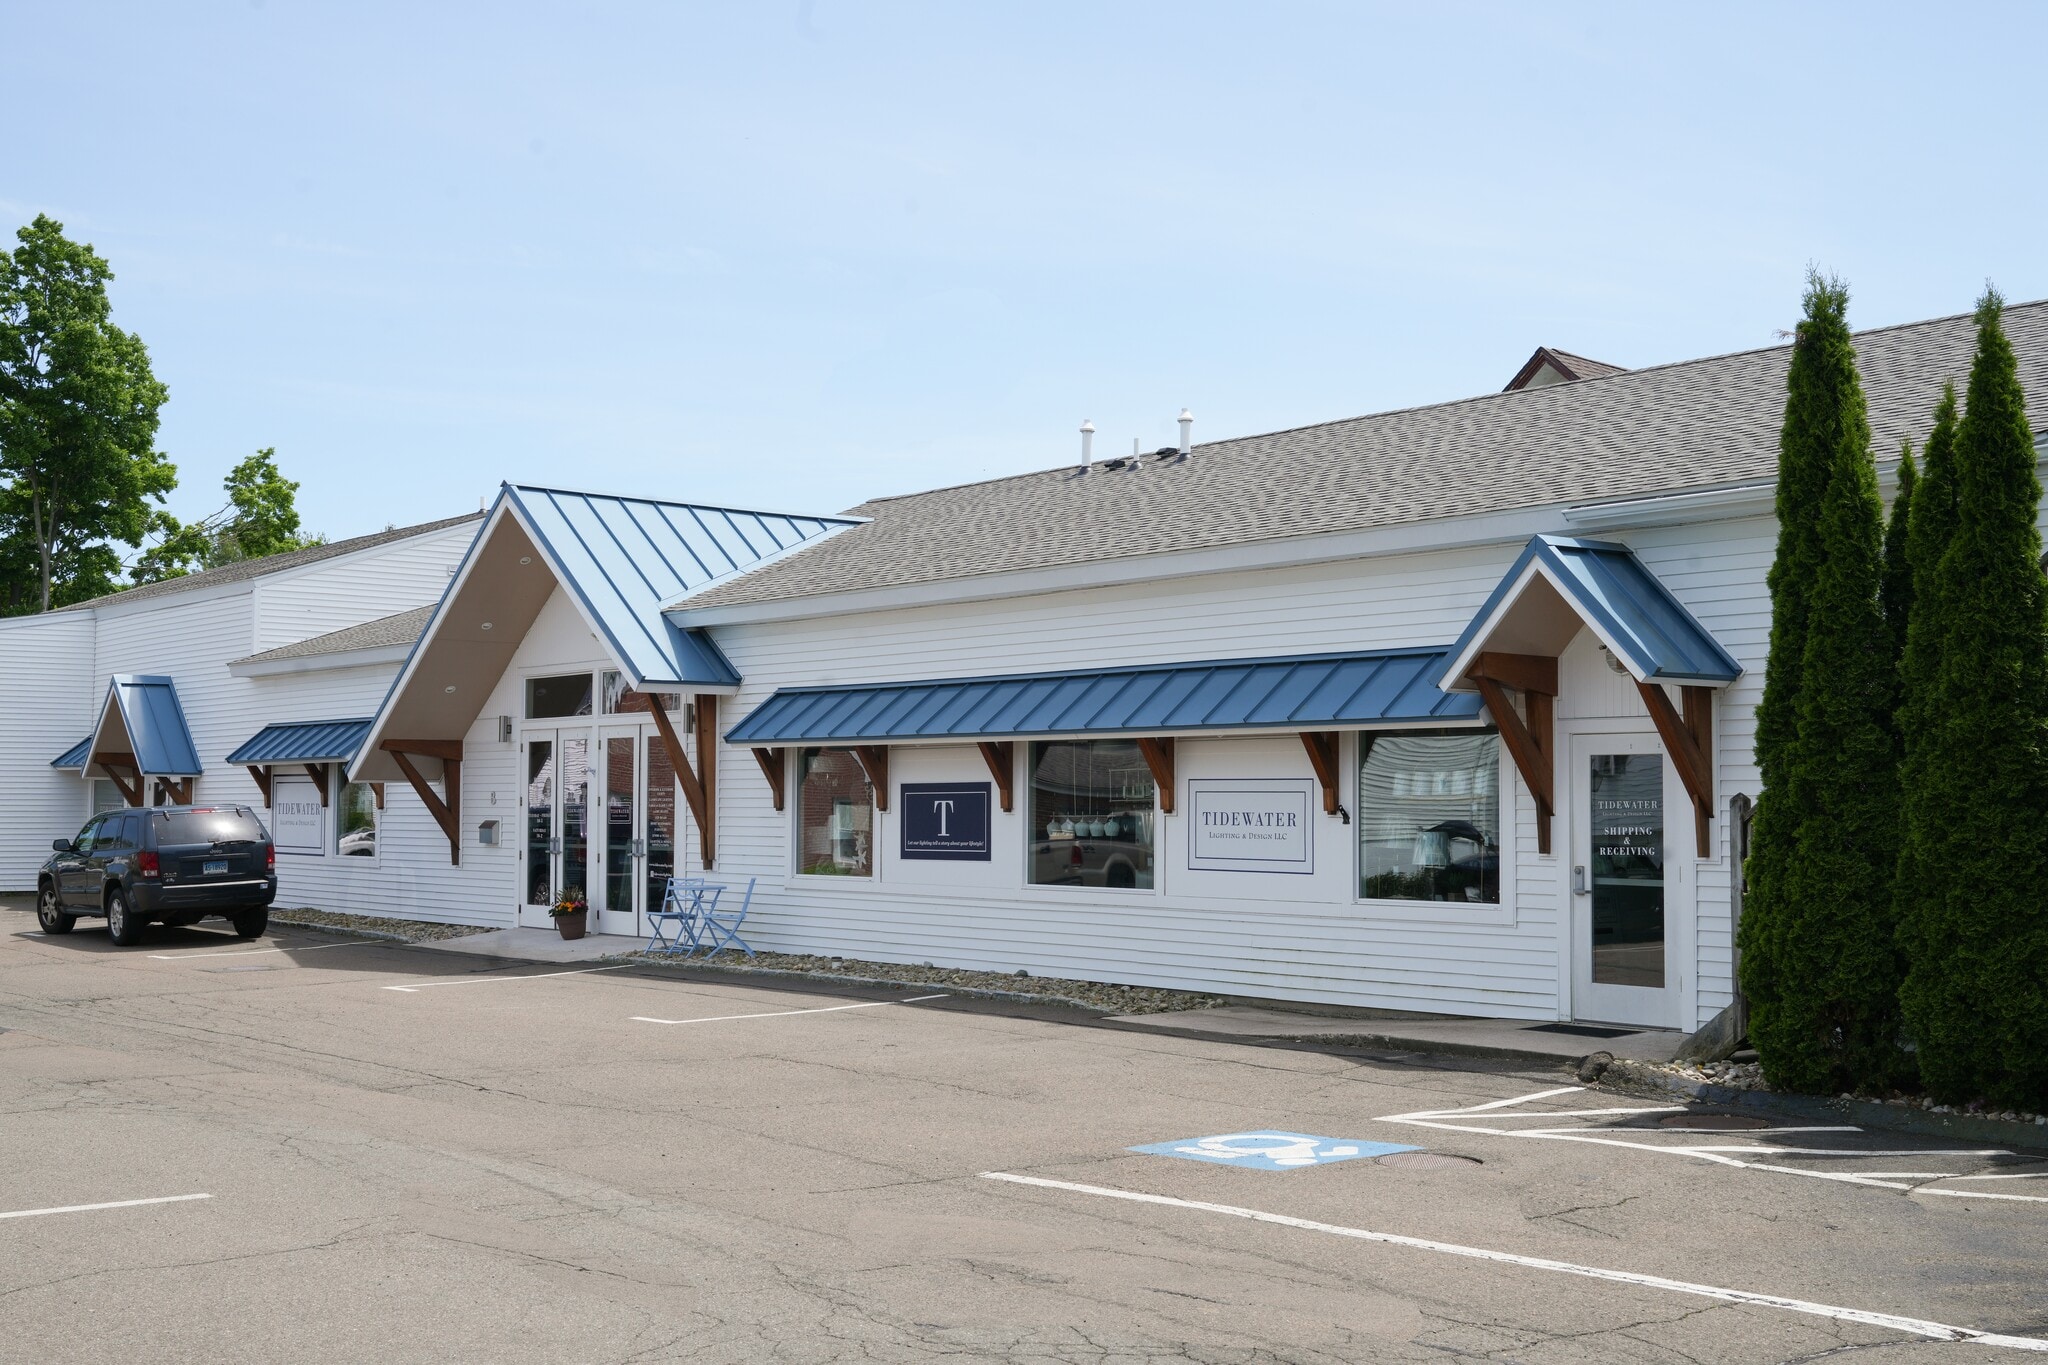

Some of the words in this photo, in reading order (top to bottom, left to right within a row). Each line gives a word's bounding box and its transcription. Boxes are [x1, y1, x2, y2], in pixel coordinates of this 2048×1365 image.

[278, 802, 320, 815] TIDEWATER
[1597, 800, 1657, 810] TIDEWATER
[933, 800, 954, 836] T
[1202, 811, 1296, 827] TIDEWATER
[1274, 832, 1287, 840] LLC
[1604, 827, 1652, 836] SHIPPING
[1623, 836, 1631, 845] &
[1600, 847, 1655, 856] RECEIVING
